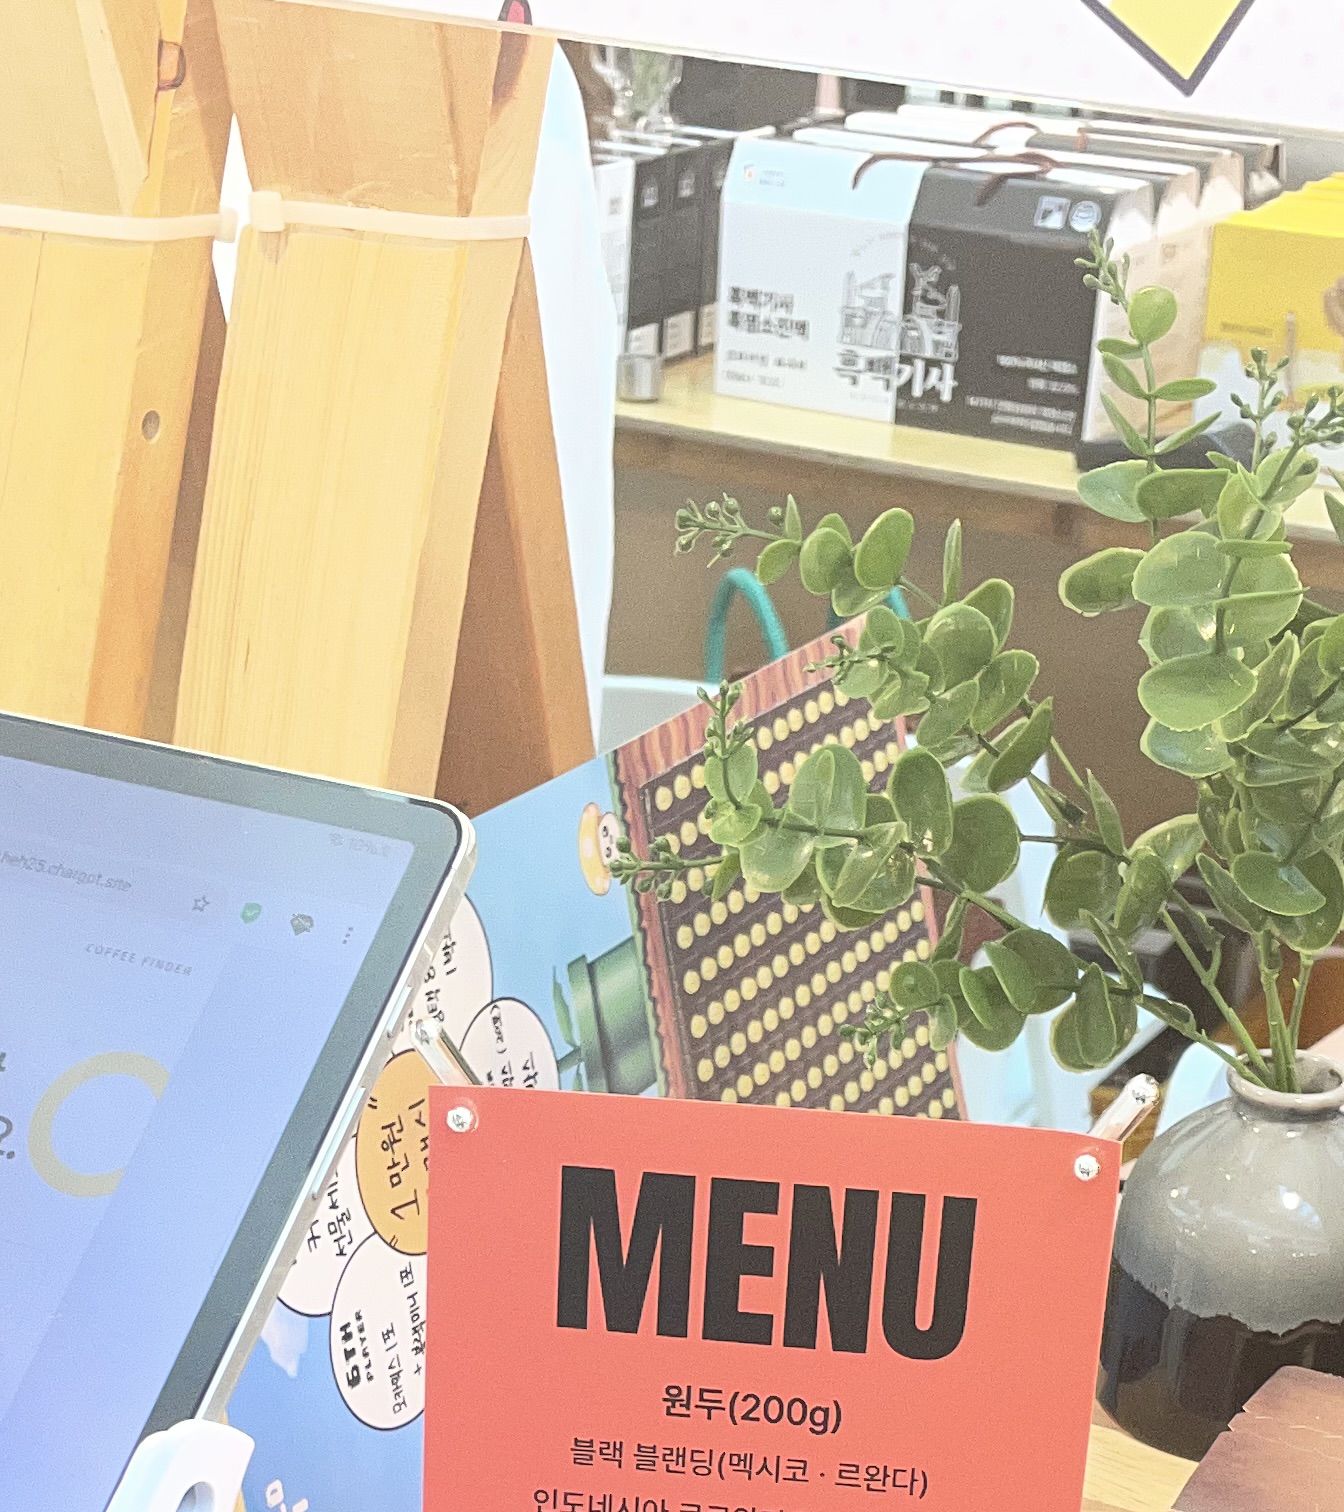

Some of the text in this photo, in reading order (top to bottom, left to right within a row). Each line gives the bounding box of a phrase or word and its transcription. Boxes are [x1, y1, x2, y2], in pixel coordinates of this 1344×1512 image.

[556, 1165, 977, 1361] MENU
[661, 1384, 844, 1435] 원두(200g)
[570, 1437, 624, 1470] 블랙
[632, 1443, 810, 1486] 블랜딩(멕시코
[834, 1462, 930, 1499] 르완다)
